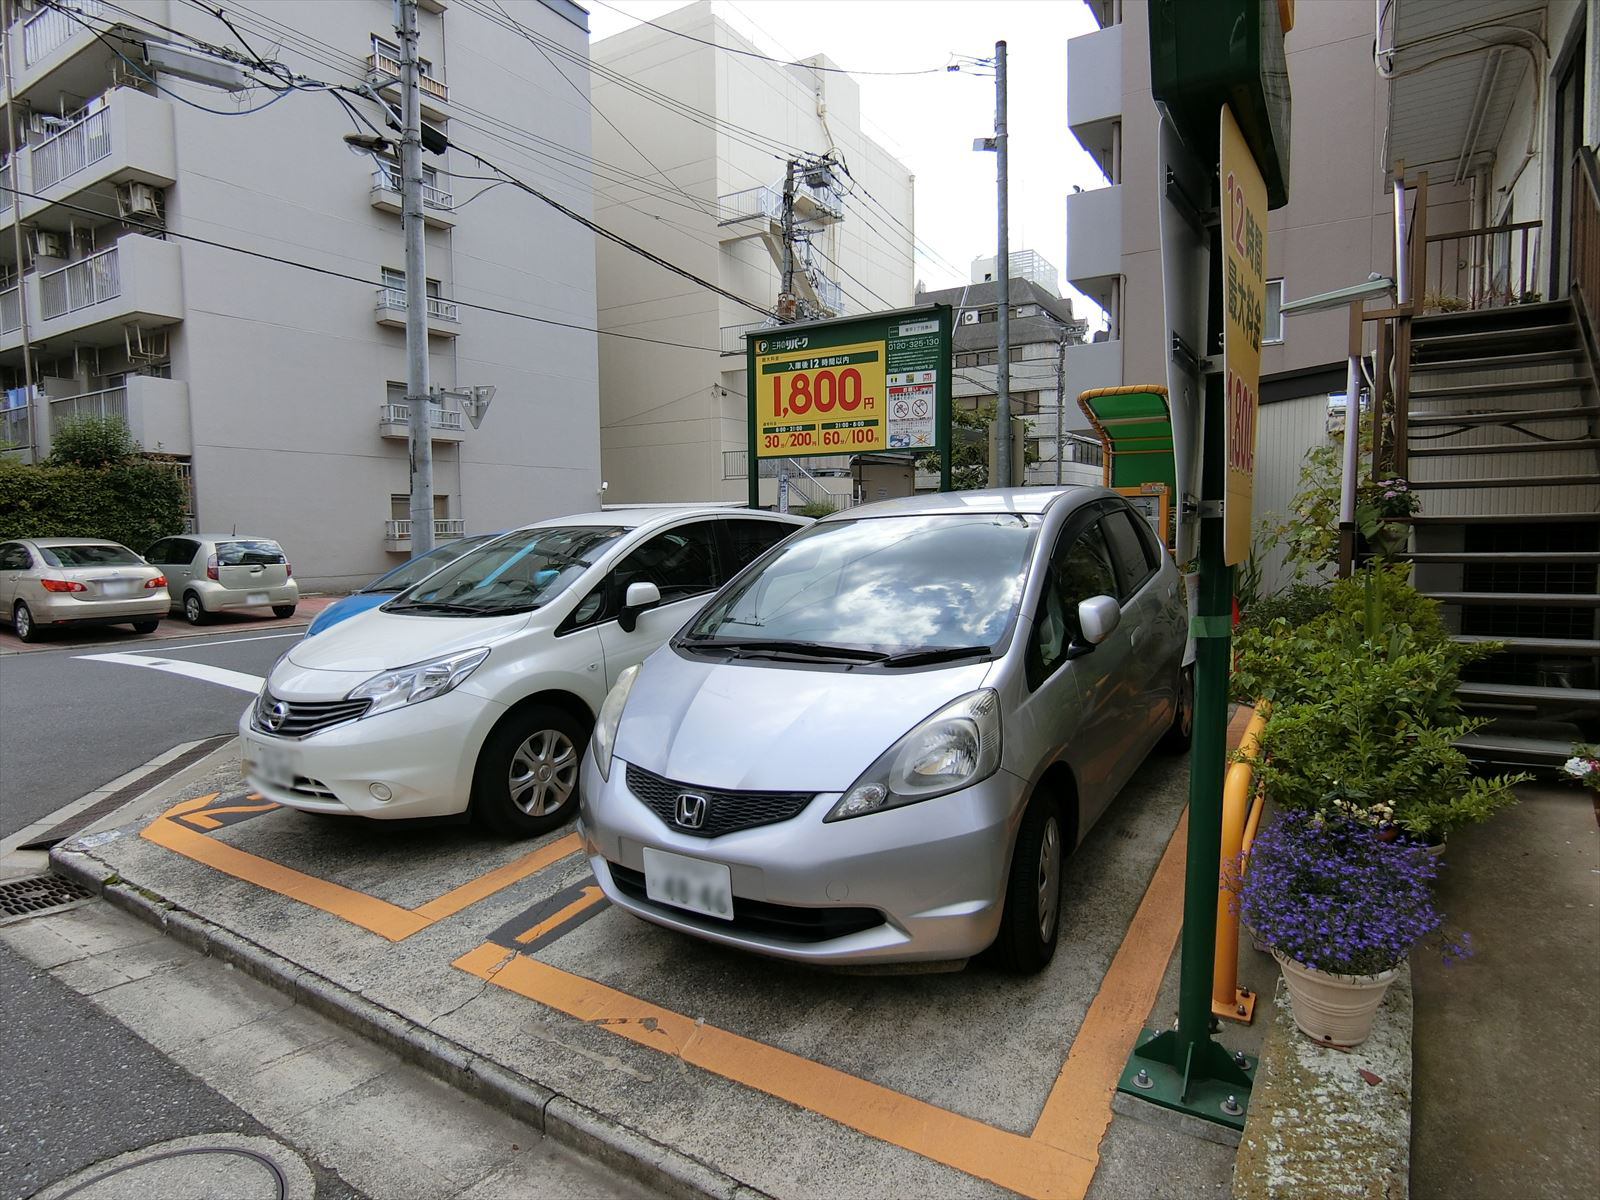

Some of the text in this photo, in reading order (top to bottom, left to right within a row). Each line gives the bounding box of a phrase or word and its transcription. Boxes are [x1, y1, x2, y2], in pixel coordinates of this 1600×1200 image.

[1227, 173, 1263, 284] 12時間
[1228, 256, 1261, 354] 最大料金
[514, 885, 607, 945] 1
